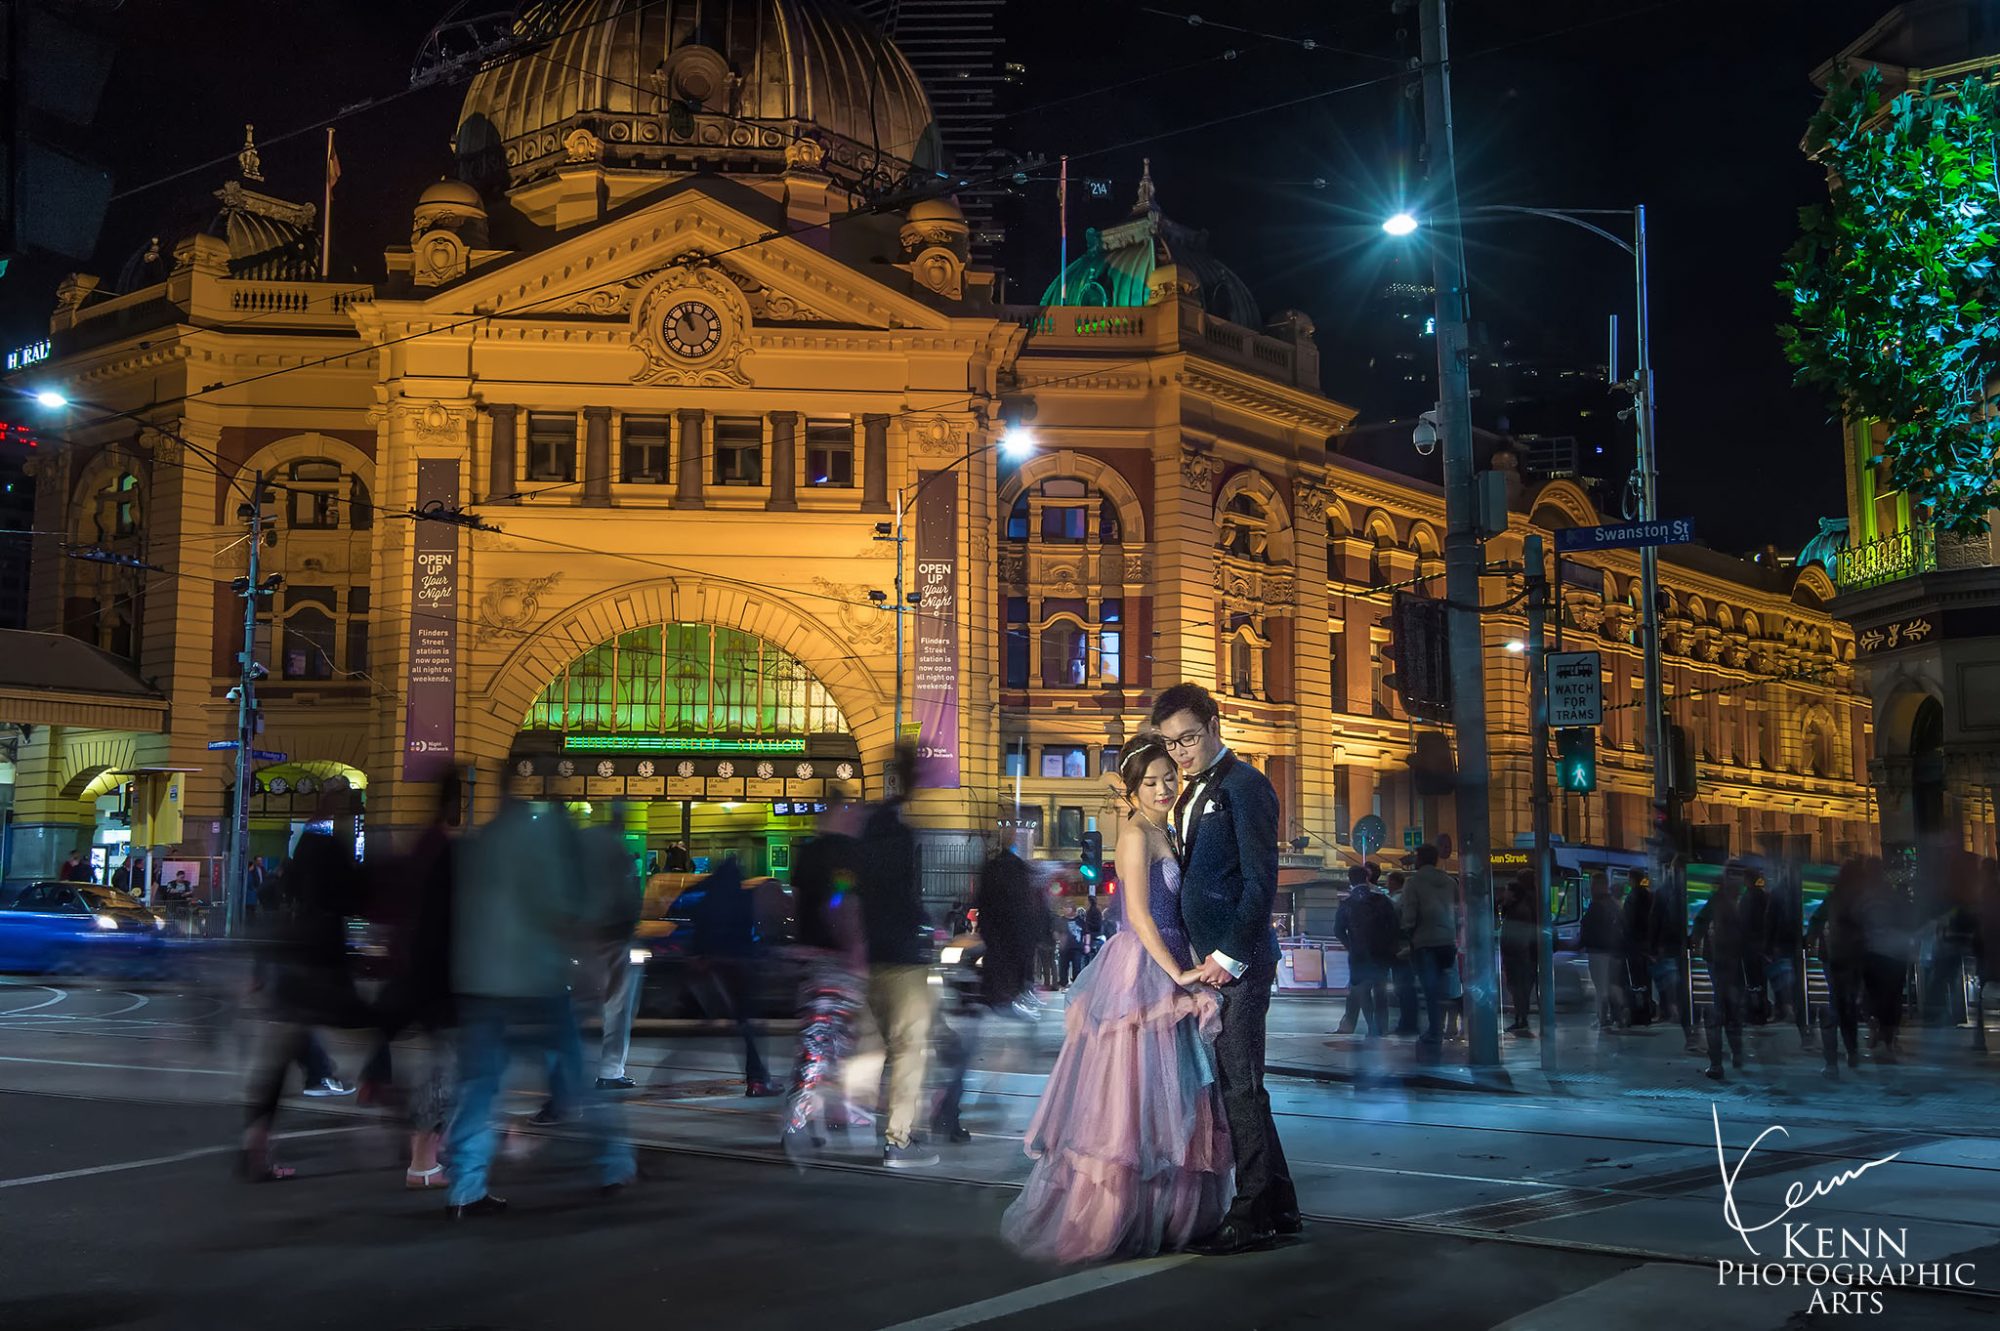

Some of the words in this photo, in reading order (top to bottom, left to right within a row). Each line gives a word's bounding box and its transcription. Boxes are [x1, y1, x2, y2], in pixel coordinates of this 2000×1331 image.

[1090, 182, 1107, 195] 214
[1595, 524, 1668, 541] Swanston
[1673, 520, 1689, 535] St
[1679, 534, 1689, 542] 41
[418, 554, 452, 565] OPEN
[427, 565, 443, 575] UP
[918, 563, 951, 574] OPEN
[421, 575, 448, 589] Your
[927, 574, 943, 584] UP
[418, 587, 452, 601] Night
[922, 584, 949, 598] Your
[920, 595, 952, 610] Night
[418, 629, 449, 637] Flinders
[920, 637, 950, 645] Flinders
[924, 646, 946, 654] Street
[423, 666, 442, 675] night
[926, 674, 944, 682] night
[916, 682, 954, 690] weekends.
[1555, 684, 1594, 695] WATCH
[1564, 696, 1586, 707] FOR
[1556, 709, 1594, 720] TRAMS
[661, 737, 718, 751] STREET
[737, 738, 806, 751] STATION
[1505, 853, 1528, 863] Street
